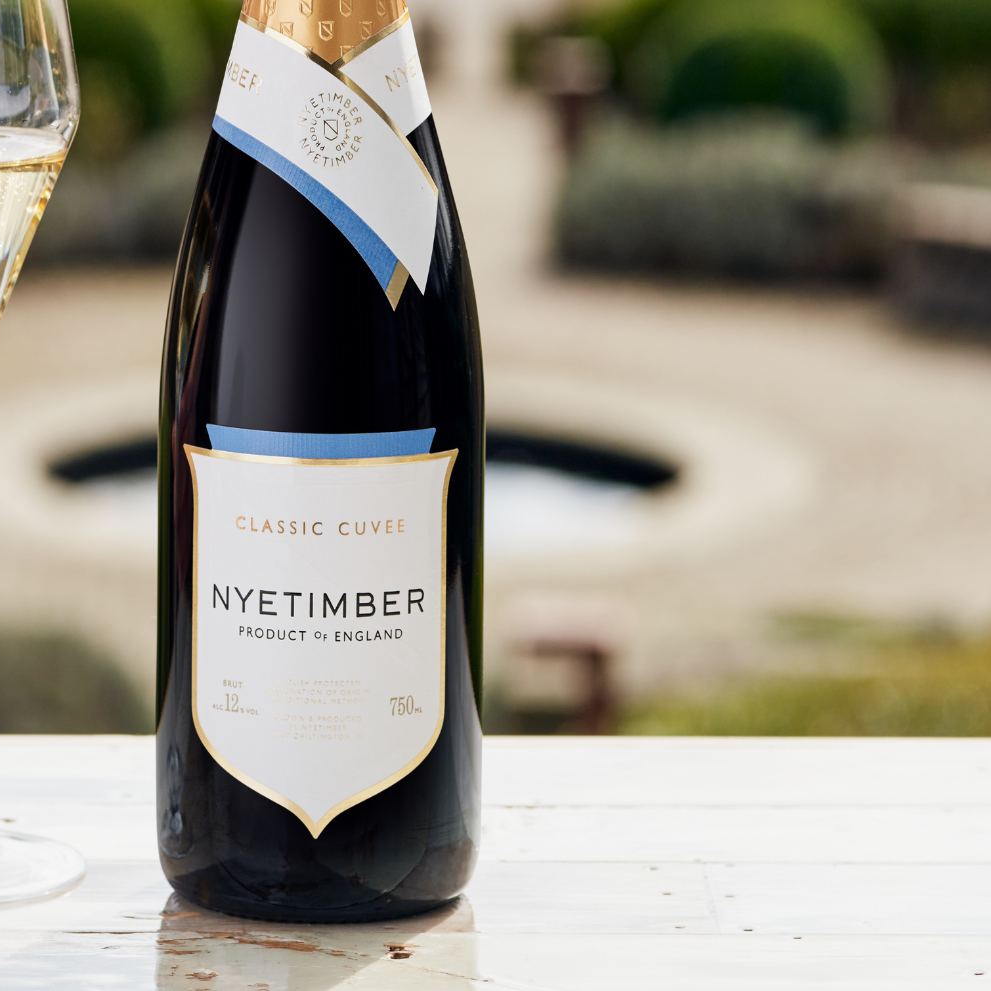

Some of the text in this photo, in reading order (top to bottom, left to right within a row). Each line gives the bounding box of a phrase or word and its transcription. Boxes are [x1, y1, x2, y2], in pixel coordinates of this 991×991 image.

[298, 93, 363, 126] NYETIMBER
[310, 107, 326, 151] PRODUCT
[336, 108, 352, 151] ENGLAND
[299, 135, 363, 167] NYETIMBER
[236, 516, 405, 536] CLASSIC CUVEE
[212, 583, 425, 618] NYETIMBER
[239, 625, 307, 641] PRODUCT
[335, 628, 403, 642] ENGLAND
[223, 679, 243, 689] BRUT
[246, 708, 259, 716] VOL
[317, 715, 362, 723] PRODUCED
[302, 724, 347, 732] NYETIMBER
